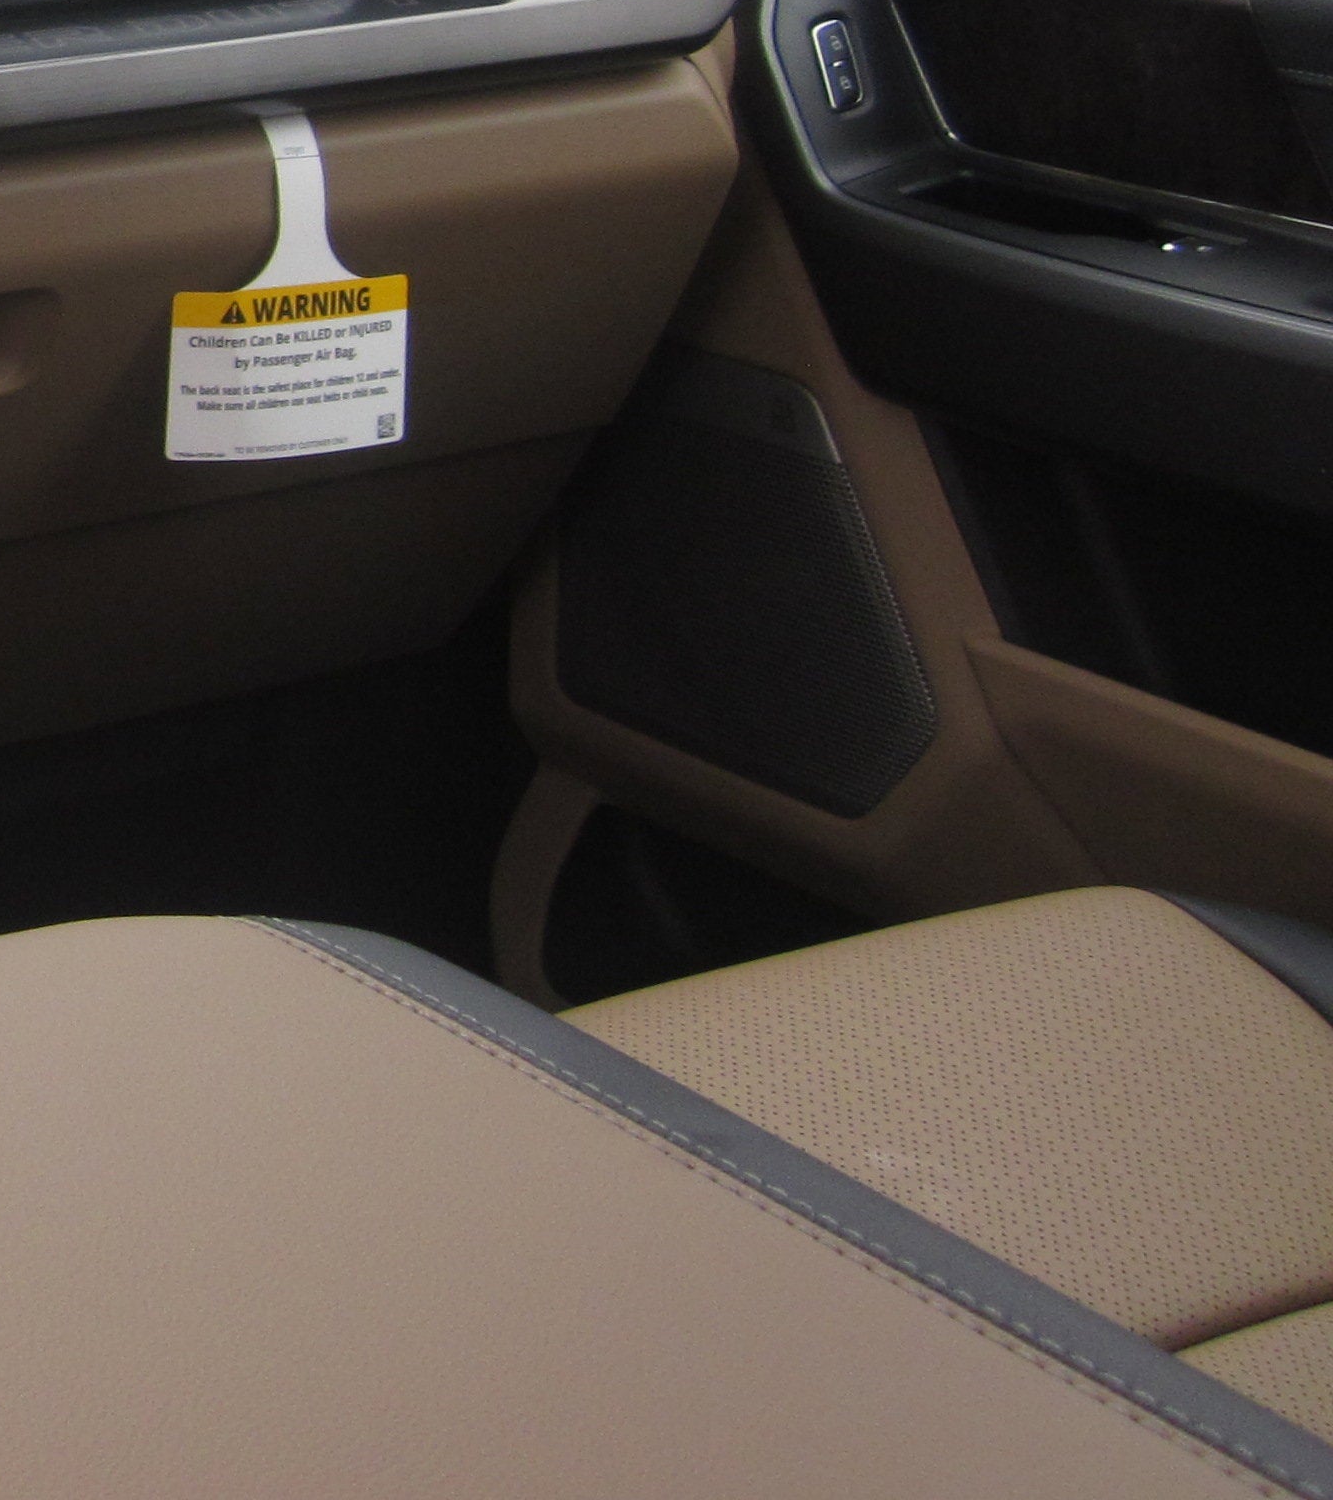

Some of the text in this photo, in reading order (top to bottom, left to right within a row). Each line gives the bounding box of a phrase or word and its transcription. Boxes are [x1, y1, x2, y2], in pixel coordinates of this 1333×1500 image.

[252, 286, 370, 323] WARNING
[189, 320, 392, 348] Children Can Be KILLED or INJURED
[235, 357, 250, 371] by
[254, 353, 313, 367] Passenger
[316, 349, 332, 361] Air
